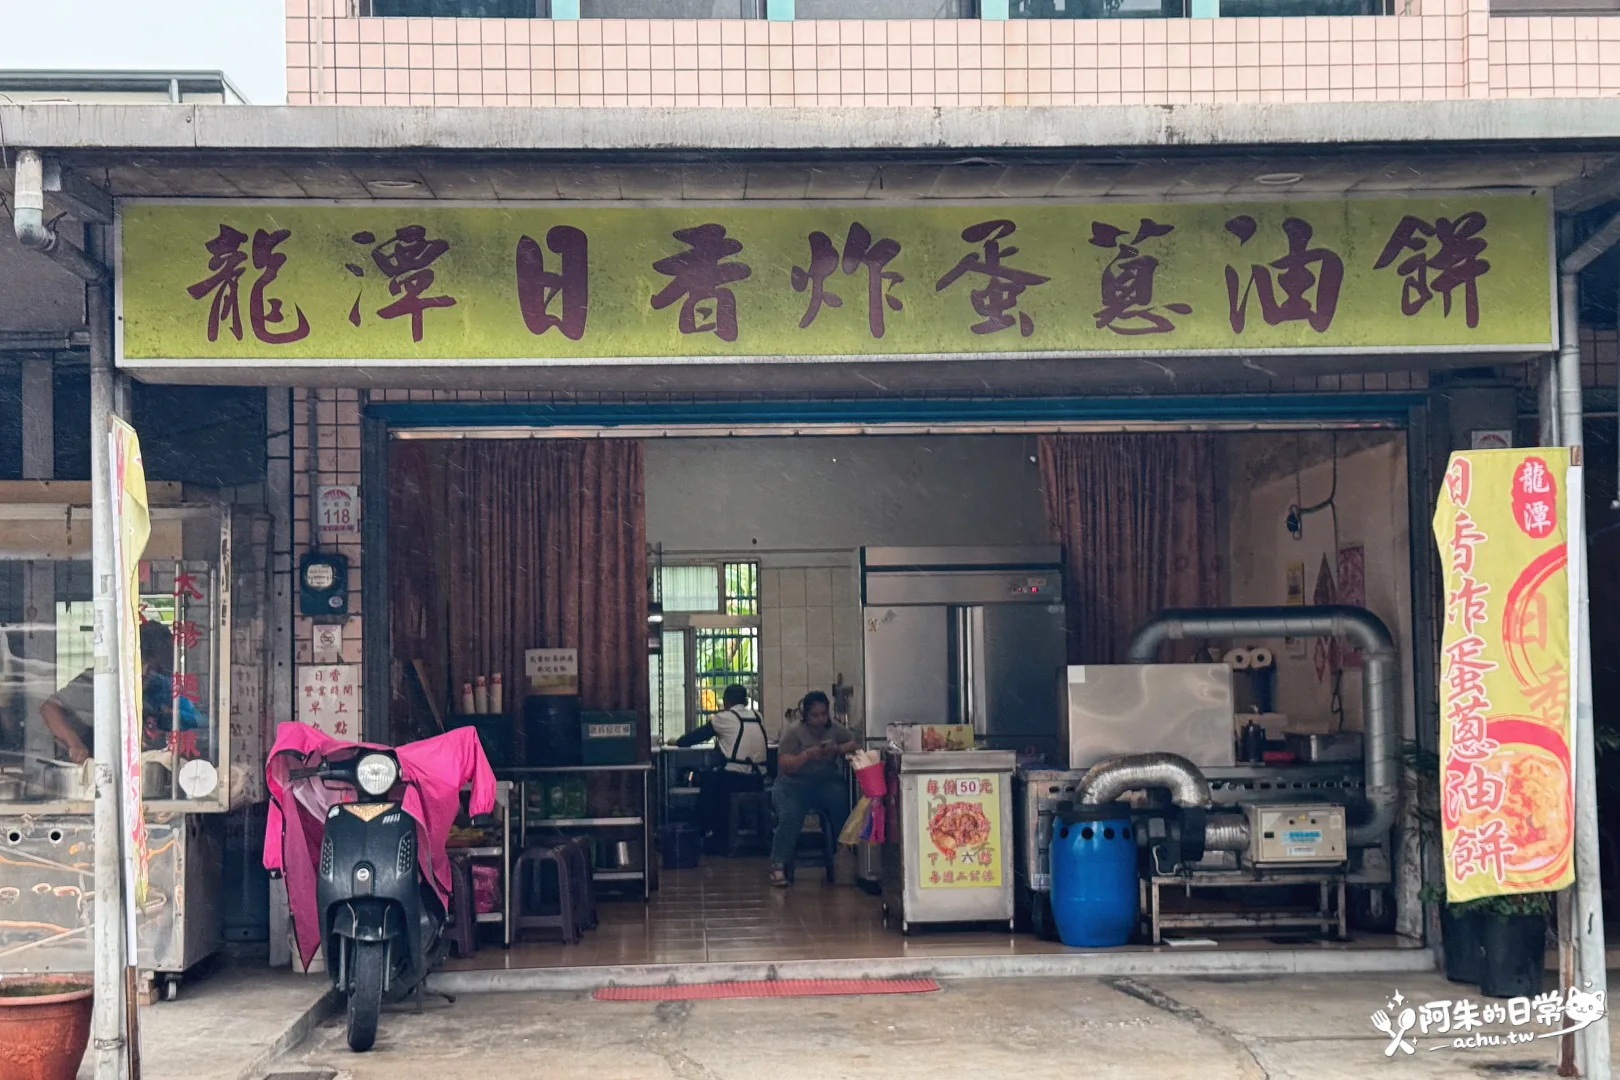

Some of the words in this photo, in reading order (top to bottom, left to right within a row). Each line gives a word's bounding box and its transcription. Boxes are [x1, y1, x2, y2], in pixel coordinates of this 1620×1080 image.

[187, 210, 1491, 345] 龍潭日香炸蛋蔥油餅
[1519, 461, 1552, 534] 龍潭
[323, 508, 350, 525] 118
[315, 668, 341, 682] 日香
[304, 684, 353, 697] 營業時間
[309, 700, 348, 716] 早上
